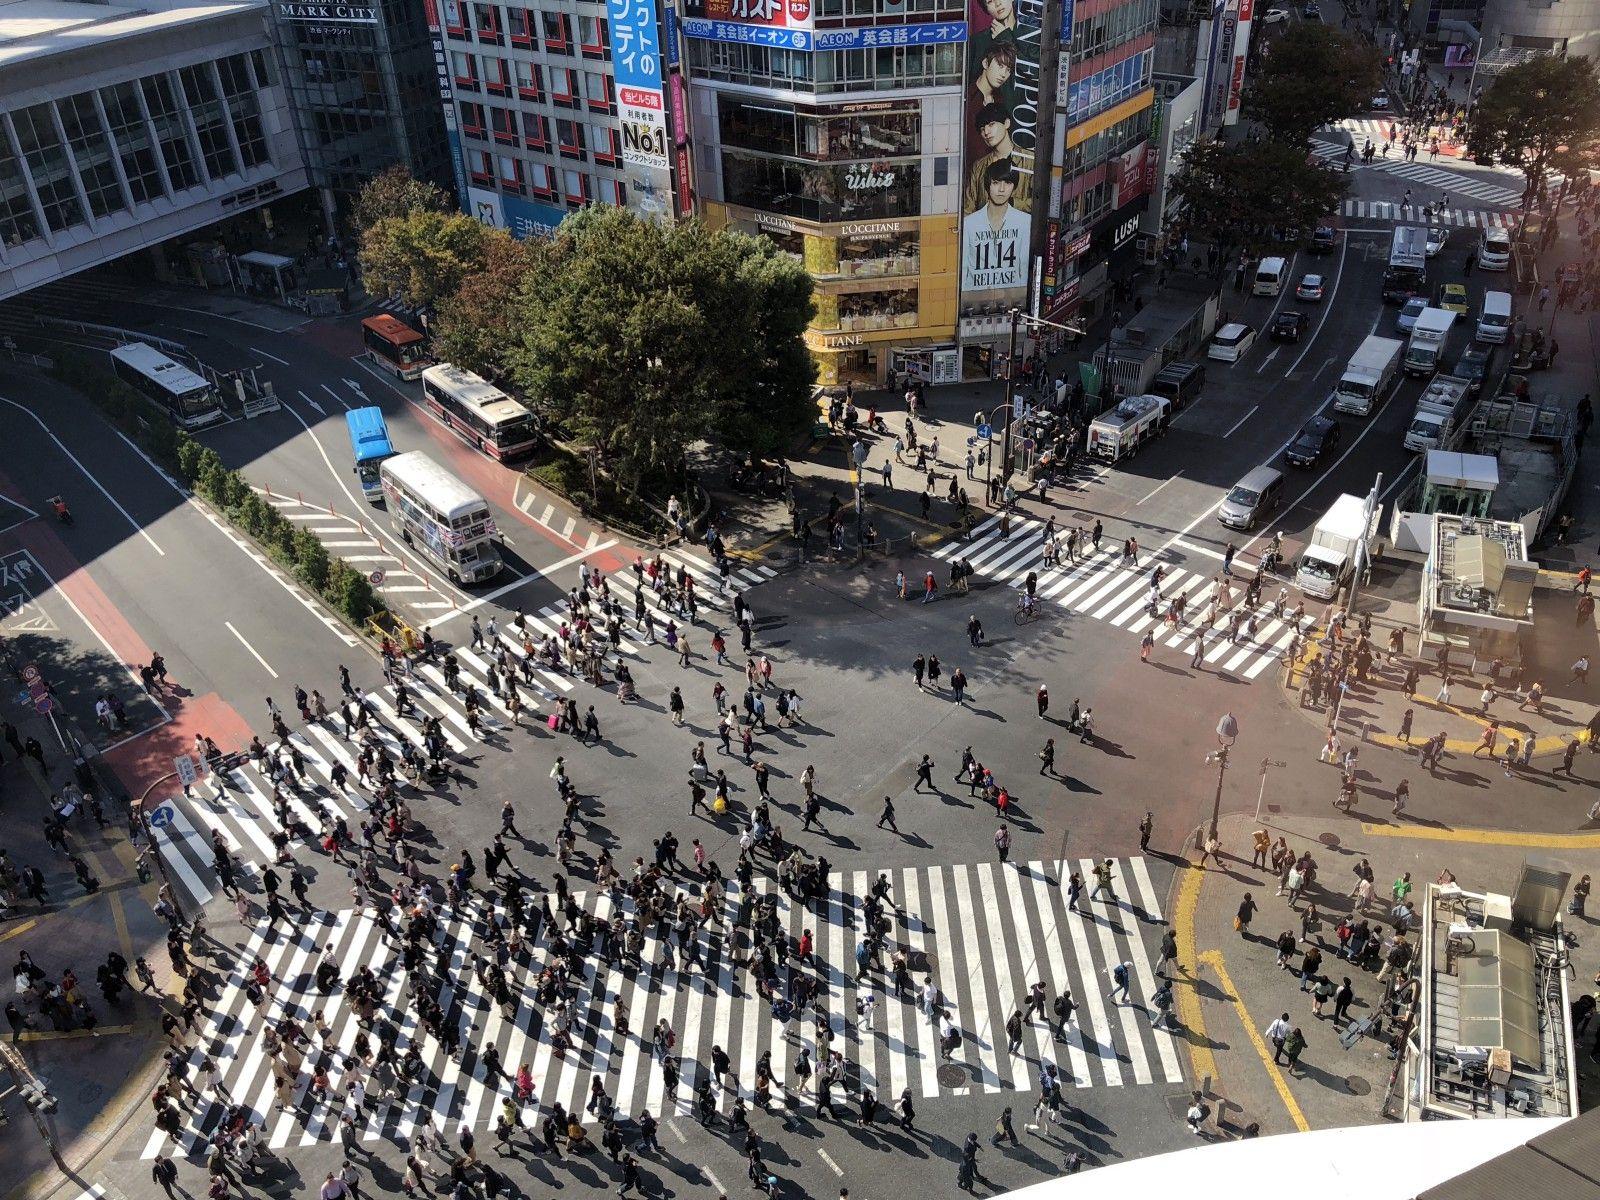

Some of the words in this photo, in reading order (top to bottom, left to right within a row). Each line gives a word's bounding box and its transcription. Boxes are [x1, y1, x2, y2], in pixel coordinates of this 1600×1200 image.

[280, 5, 329, 17] MARK
[336, 6, 376, 18] CITY
[791, 4, 808, 12] ガスト
[635, 0, 655, 75] クトの
[686, 22, 709, 35] AEON
[716, 24, 788, 43] 英会話イーオン
[820, 34, 853, 46] AEON
[863, 26, 964, 45] 英会話イーオン
[624, 91, 659, 107] 当ビル5階
[627, 109, 655, 122] 利用者数
[621, 121, 666, 157] No.1
[624, 152, 667, 167] コンタクトショップ
[515, 216, 556, 240] 三井住友
[754, 213, 796, 230] L'OCCITANE
[842, 222, 900, 235] L'OCCITANE
[1114, 214, 1139, 244] LUSH
[975, 231, 992, 241] NEW
[974, 240, 1017, 270] 11.14
[973, 270, 1016, 286] RELEASE
